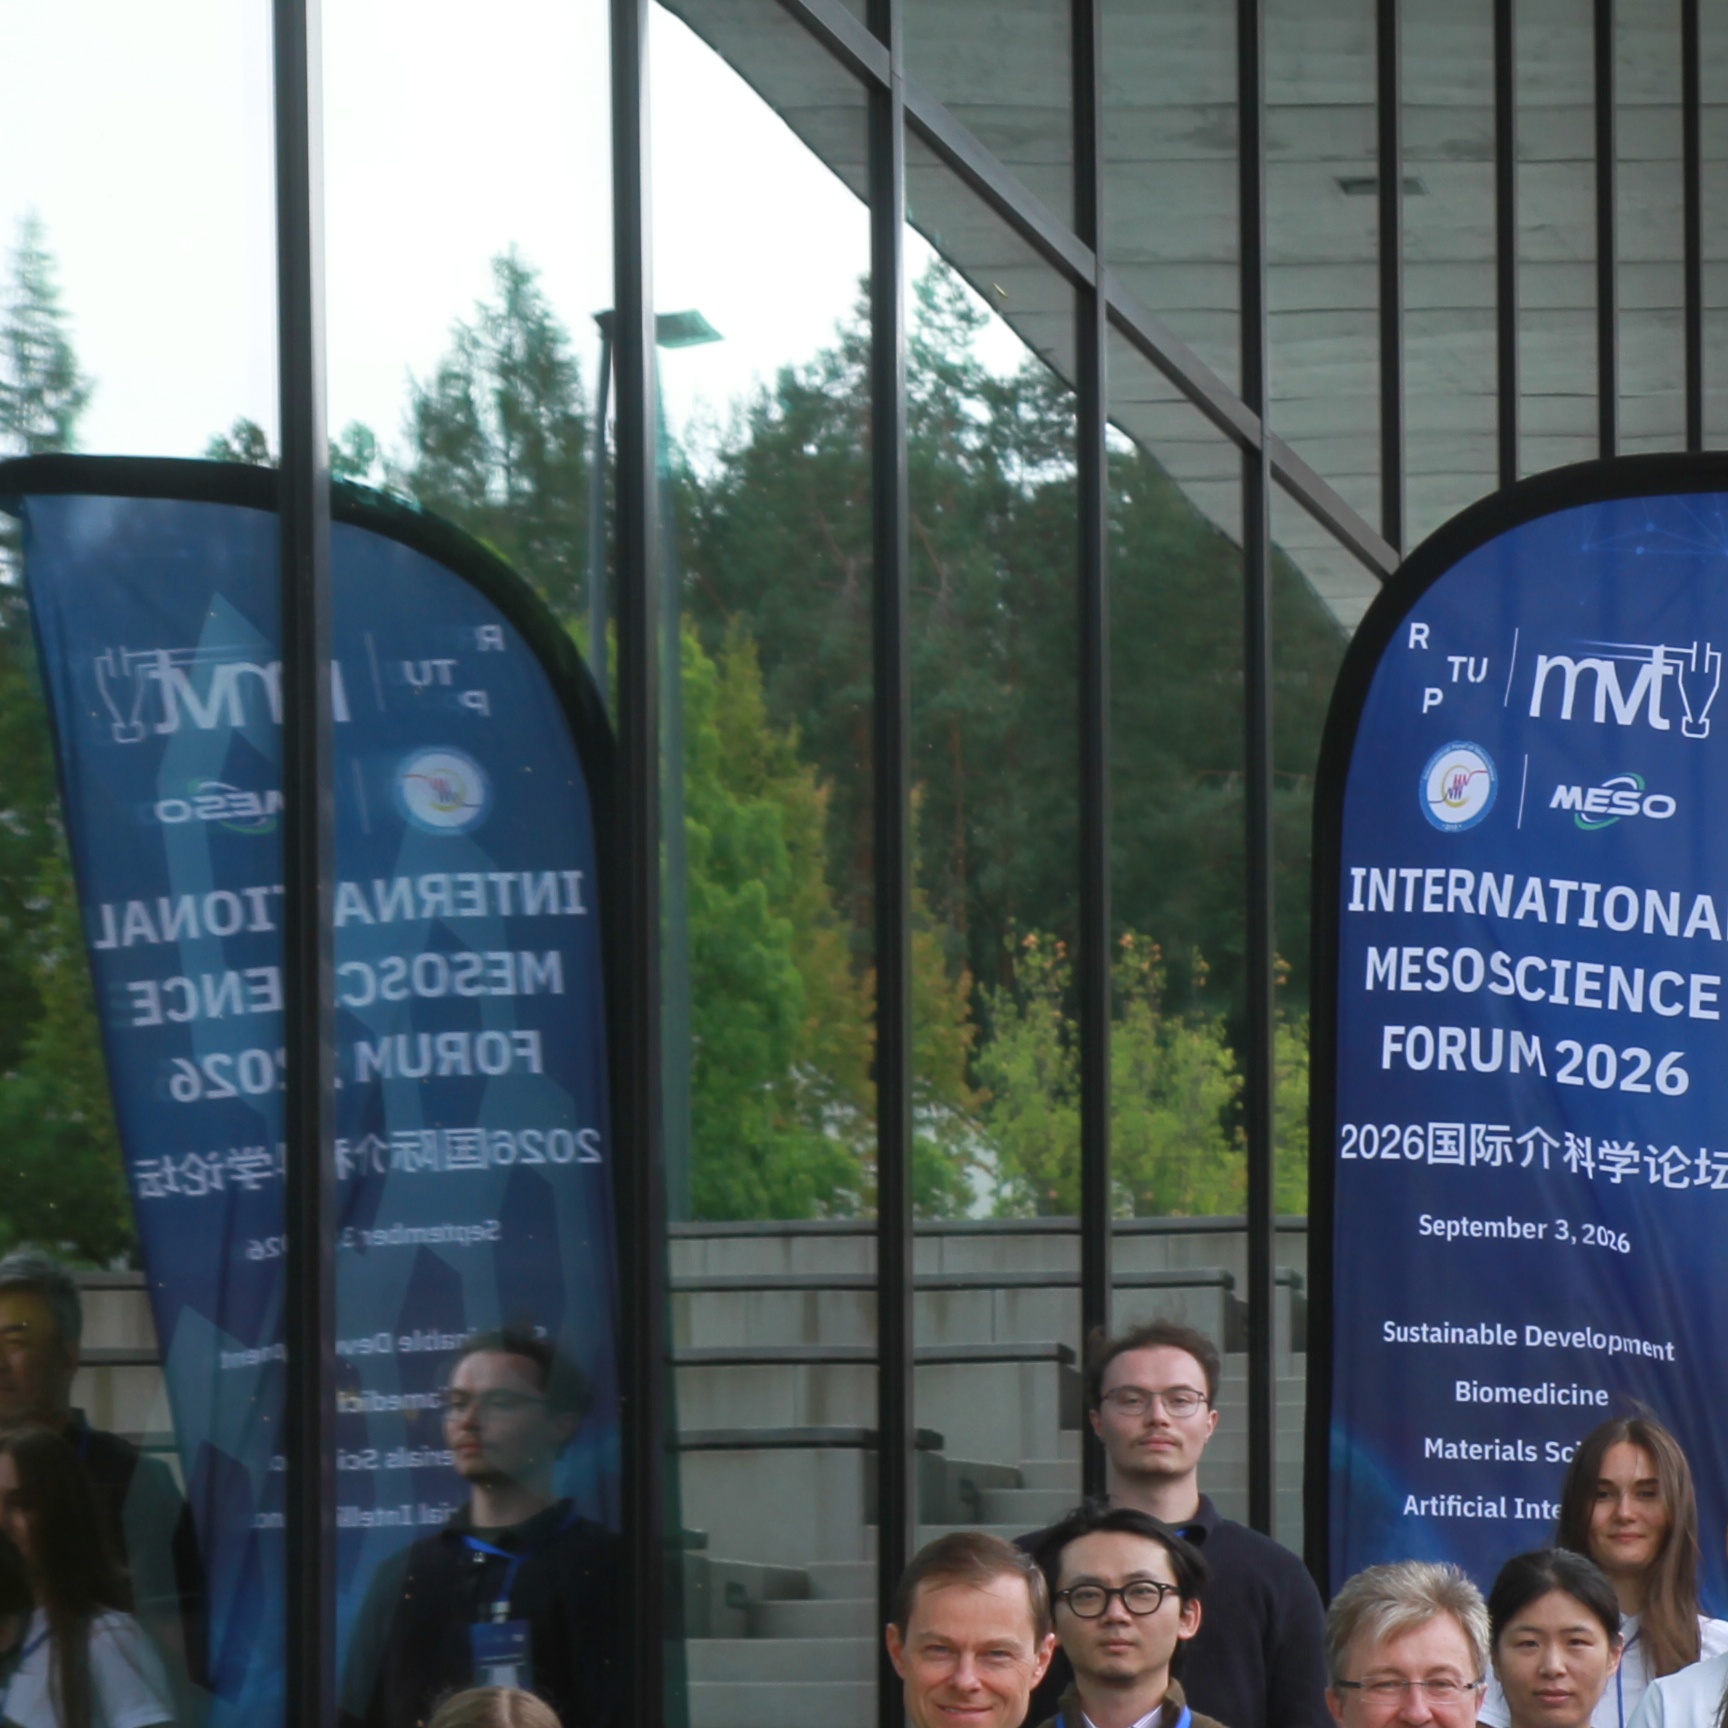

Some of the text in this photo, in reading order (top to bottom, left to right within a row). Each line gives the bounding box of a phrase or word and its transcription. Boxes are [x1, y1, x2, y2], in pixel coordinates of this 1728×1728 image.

[1549, 784, 1677, 820] MESO
[1364, 945, 1722, 1021] MESOSCIENCE
[1380, 1025, 1690, 1097] FORUM 2026
[1418, 1214, 1631, 1255] September 3, 2026
[1382, 1320, 1676, 1362] Sustainable Development
[1454, 1379, 1609, 1407] Biomedicine
[1423, 1436, 1538, 1463] Materials
[1403, 1494, 1562, 1520] Artificial Inte
